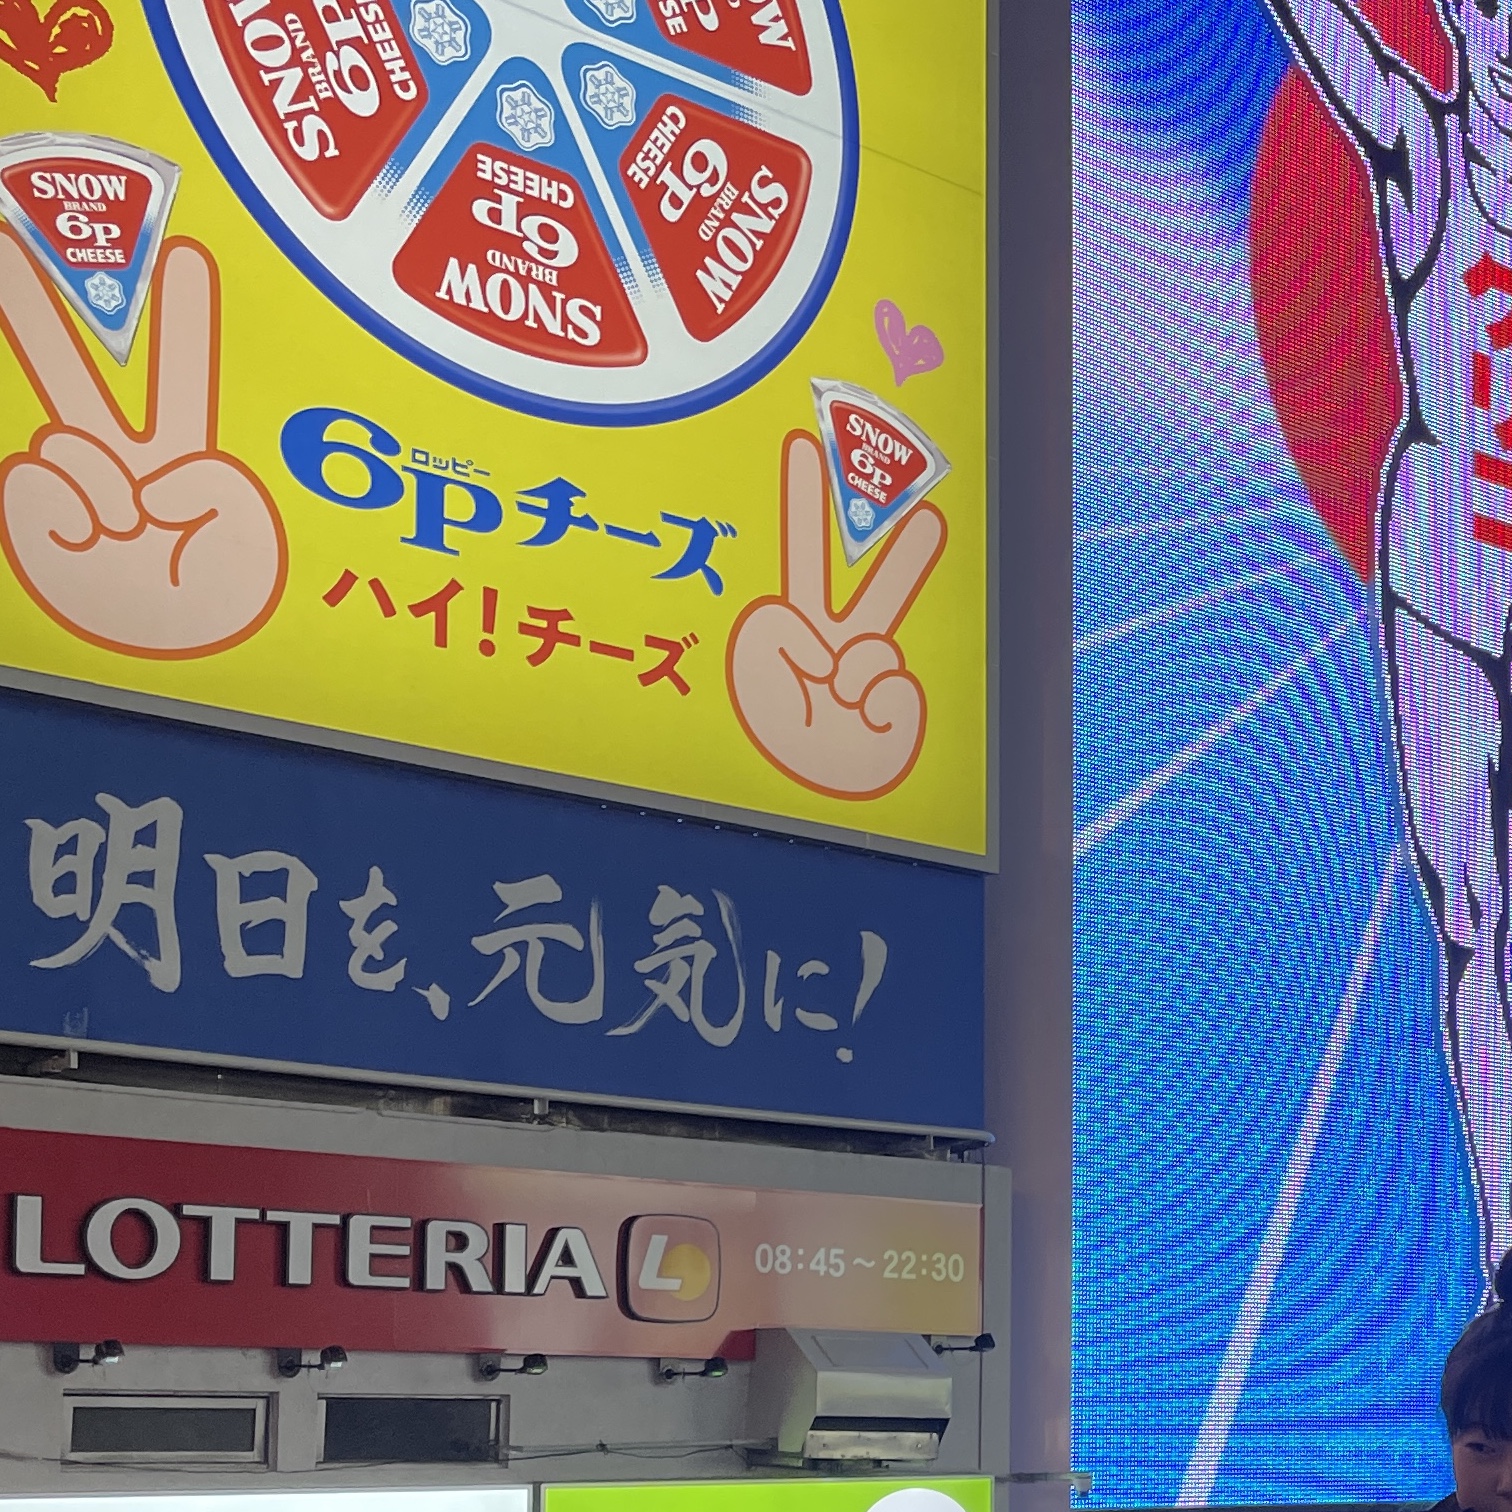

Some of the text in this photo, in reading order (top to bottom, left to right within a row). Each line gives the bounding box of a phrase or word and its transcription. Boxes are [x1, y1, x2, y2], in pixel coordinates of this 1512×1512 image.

[283, 12, 334, 100] BRAND
[356, 0, 418, 101] CHEES
[626, 105, 687, 190] CHEESE
[30, 171, 127, 202] SNOW
[63, 200, 107, 212] BRAND
[476, 153, 575, 209] CHEESE
[697, 180, 740, 242] BRAND
[65, 247, 126, 264] CHEESE
[486, 248, 559, 287] BRAND
[695, 164, 790, 315] SNOW
[435, 256, 602, 347] SNOW
[410, 447, 492, 478] ロッピー
[845, 413, 914, 466] SNOW
[861, 442, 892, 466] BRAND
[847, 472, 888, 504] CHEESE
[22, 790, 890, 1066] 明日を、元気に!
[13, 1193, 609, 1300] LOTTERIA
